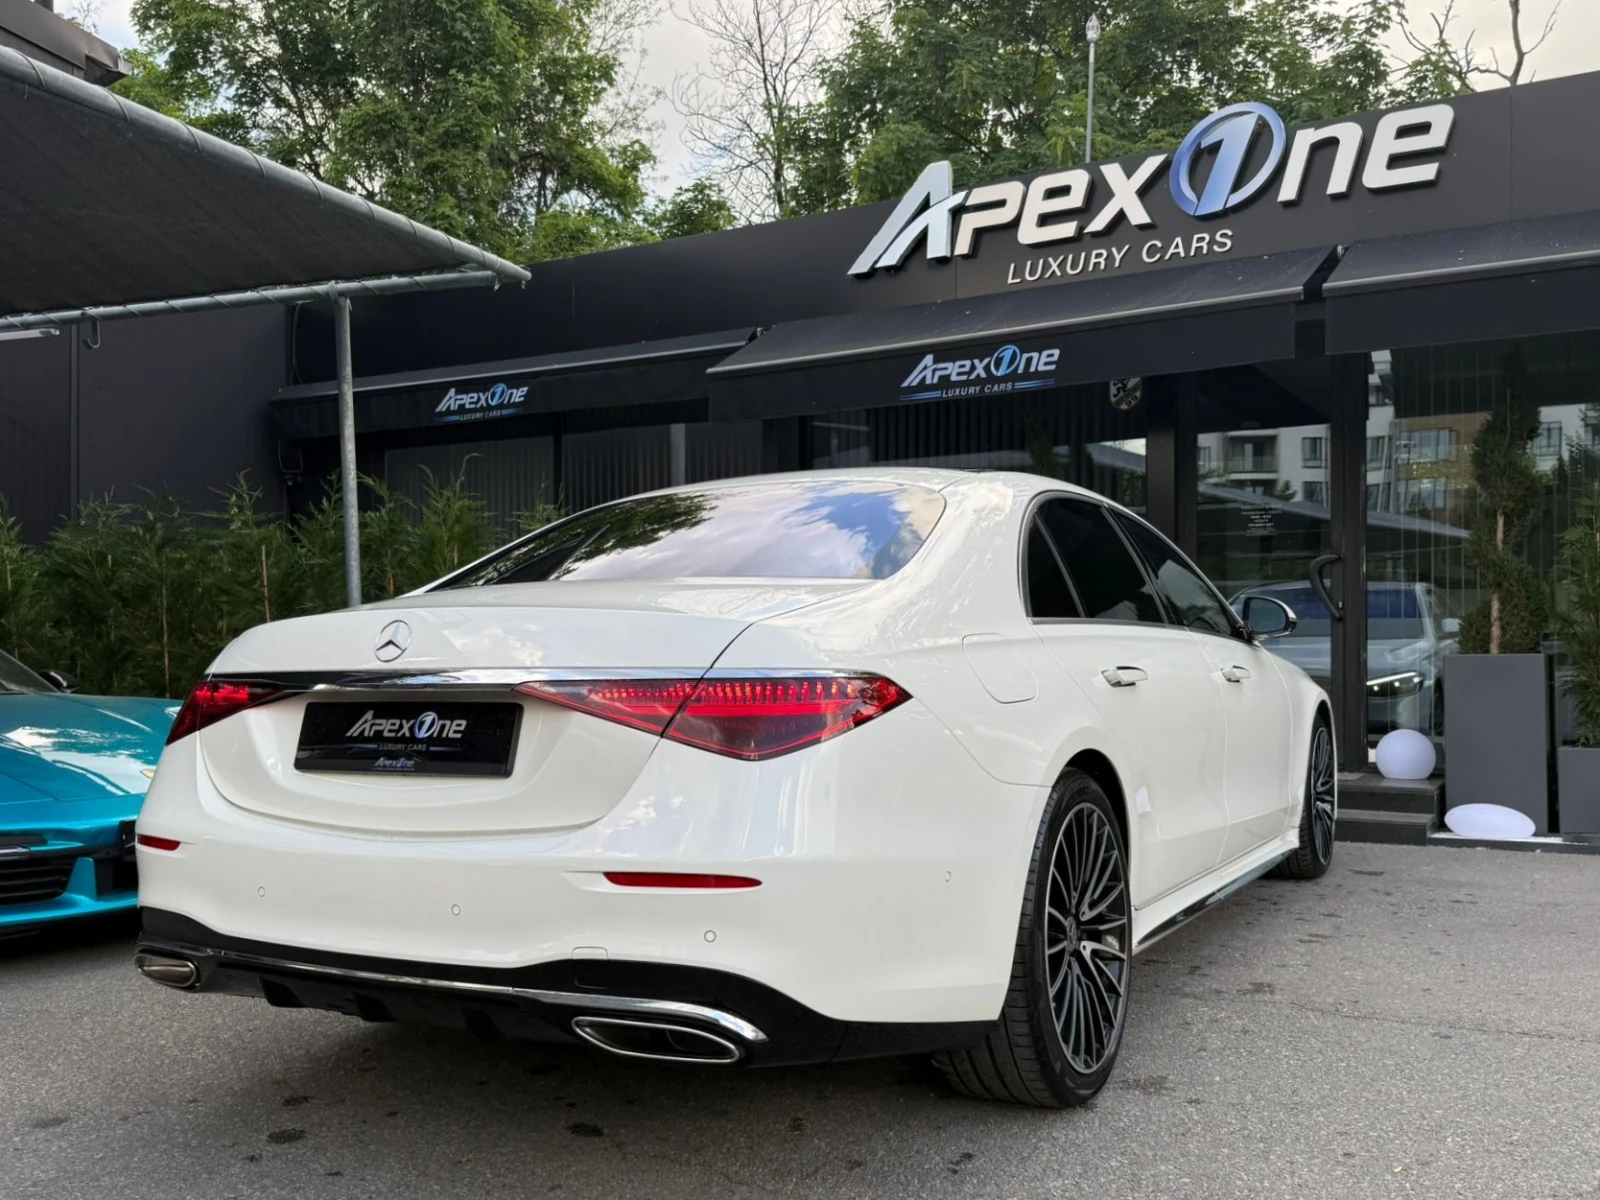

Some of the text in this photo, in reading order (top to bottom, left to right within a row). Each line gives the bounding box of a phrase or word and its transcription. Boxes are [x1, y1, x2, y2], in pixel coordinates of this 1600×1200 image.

[1007, 229, 1234, 285] LUXURY CARS
[942, 381, 1013, 398] LUXURY CARS
[379, 743, 427, 751] LUXURY CARS
